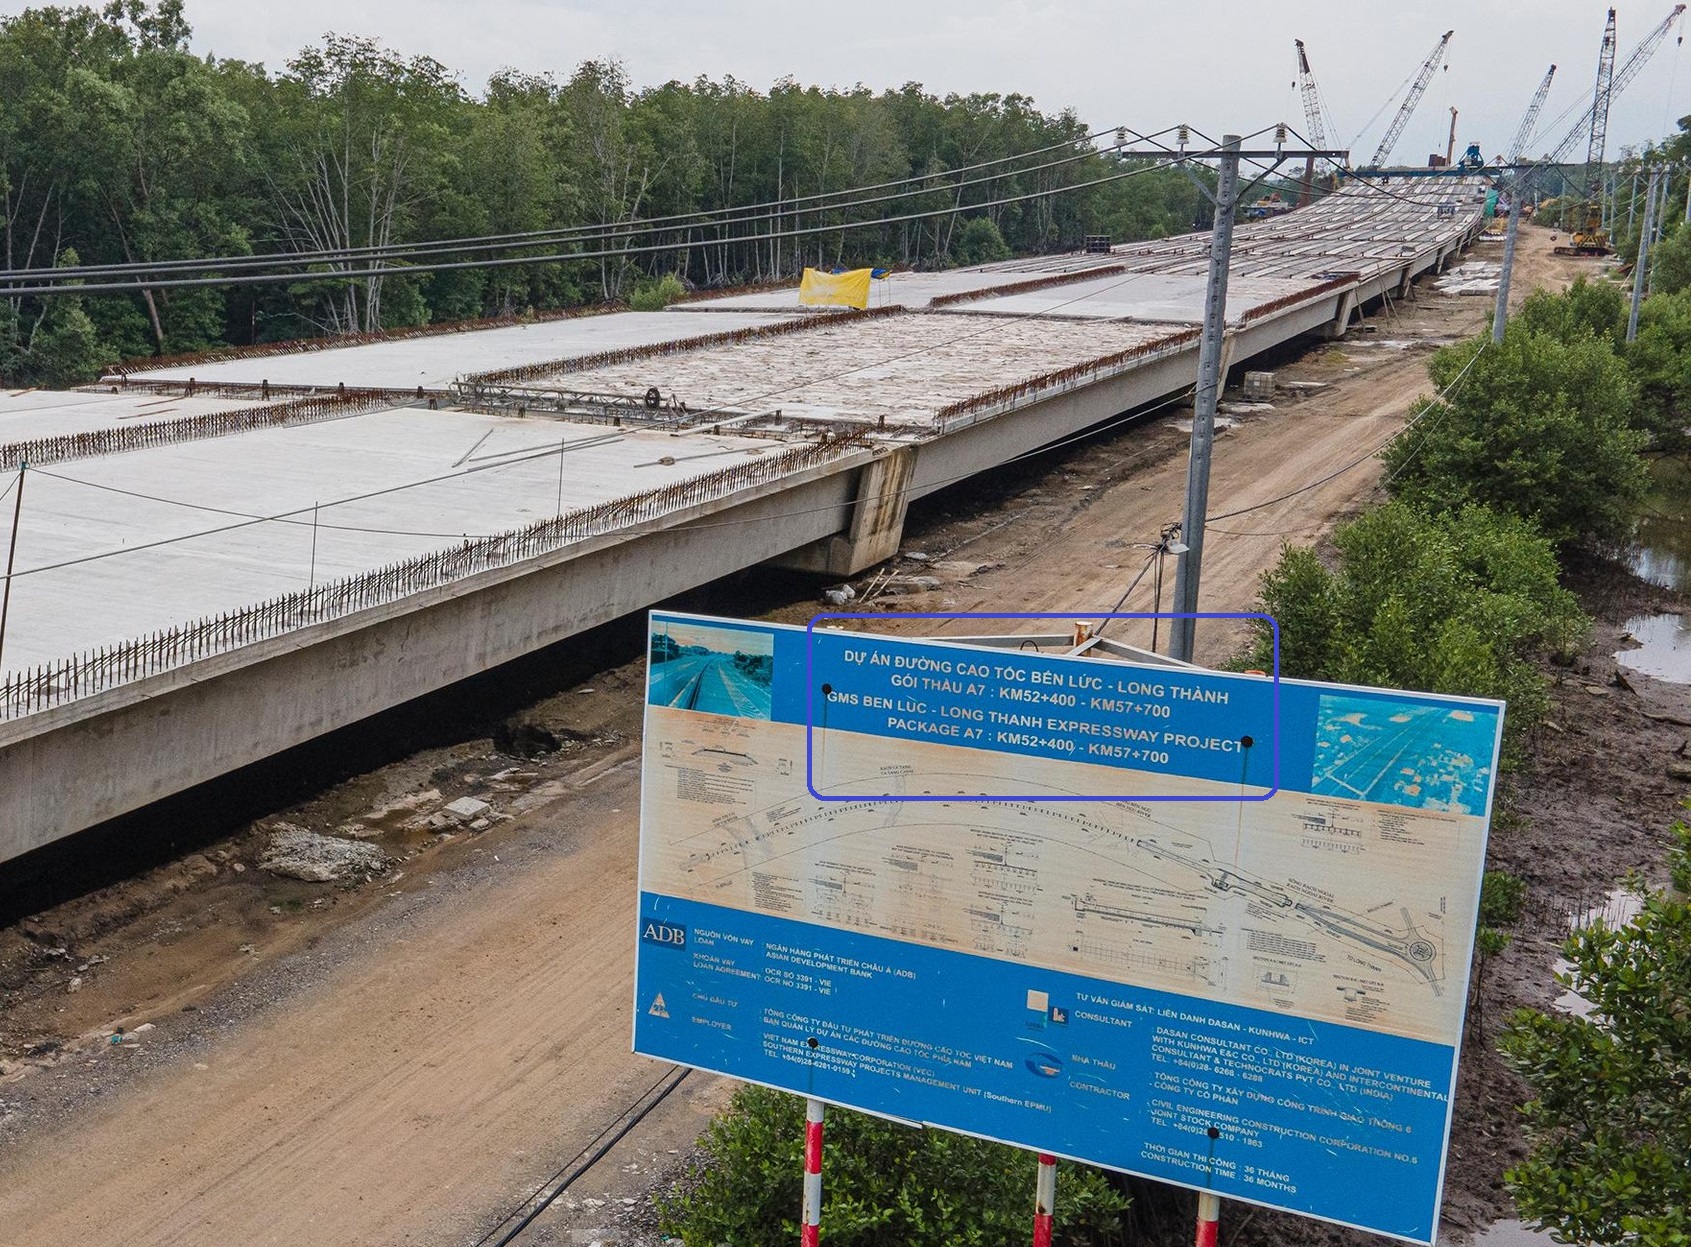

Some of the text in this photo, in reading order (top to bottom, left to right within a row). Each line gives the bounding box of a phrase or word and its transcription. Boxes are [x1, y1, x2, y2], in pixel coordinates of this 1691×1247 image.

[844, 649, 866, 666] DỰ
[894, 653, 952, 673] ĐƯỜNG
[956, 662, 989, 678] CAO
[1068, 672, 1102, 690] LỨC
[1117, 680, 1165, 698] LONG
[1169, 683, 1229, 705] THÀNH
[890, 671, 917, 688] GÓI
[966, 682, 985, 696] A7
[999, 686, 1076, 708] KM52+400
[1090, 697, 1171, 718] KM57+700
[826, 690, 858, 705] GMS
[862, 695, 892, 709] BEN
[940, 705, 984, 721] LONG
[988, 710, 1042, 728] THANH
[1046, 717, 1159, 743] EXPRESSWAY
[1163, 732, 1242, 753] PROJECT
[887, 716, 960, 737] PACKAGE
[963, 727, 982, 740] A7
[997, 731, 1074, 752] KM52+400
[1088, 742, 1169, 764] KM57+700
[643, 922, 685, 945] ADB
[1074, 1010, 1132, 1028] CONSULTANT
